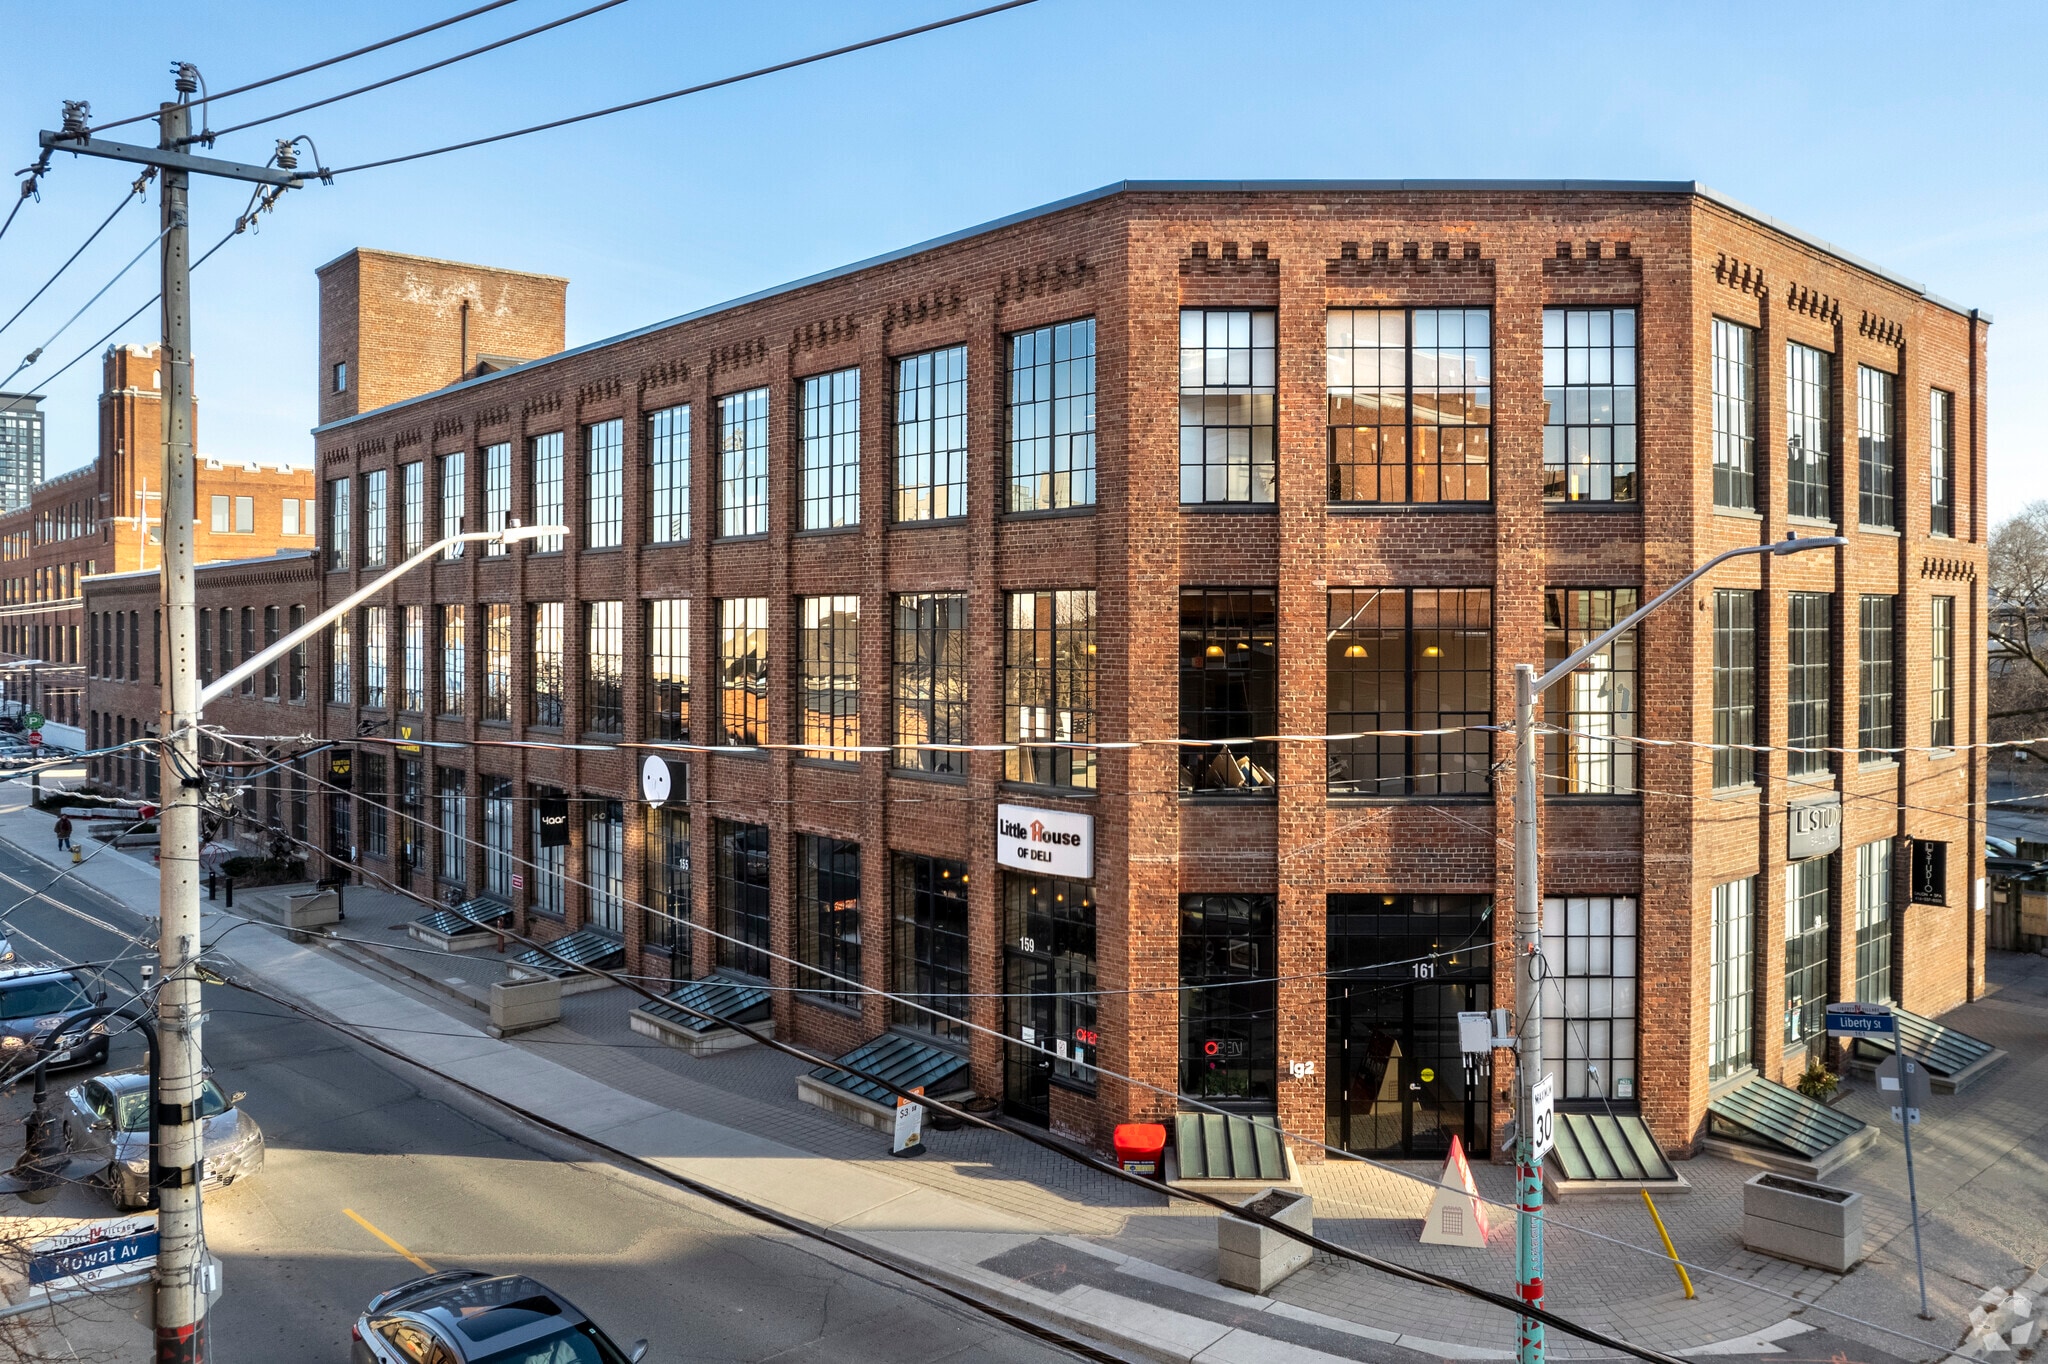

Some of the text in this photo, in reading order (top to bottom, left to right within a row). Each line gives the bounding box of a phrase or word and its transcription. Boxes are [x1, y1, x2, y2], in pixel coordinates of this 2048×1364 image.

[1000, 818, 1081, 847] Little House
[1017, 846, 1052, 863] OF DELI
[679, 858, 689, 871] 155
[1020, 936, 1035, 953] 159
[1412, 963, 1435, 978] 161
[1840, 1017, 1882, 1031] Liberty St
[1204, 1041, 1243, 1055] OPEN
[1534, 1085, 1552, 1105] MAXIMUM
[1536, 1108, 1552, 1148] 30
[103, 1222, 137, 1236] VILLAGE
[55, 1244, 139, 1273] Mowat Av
